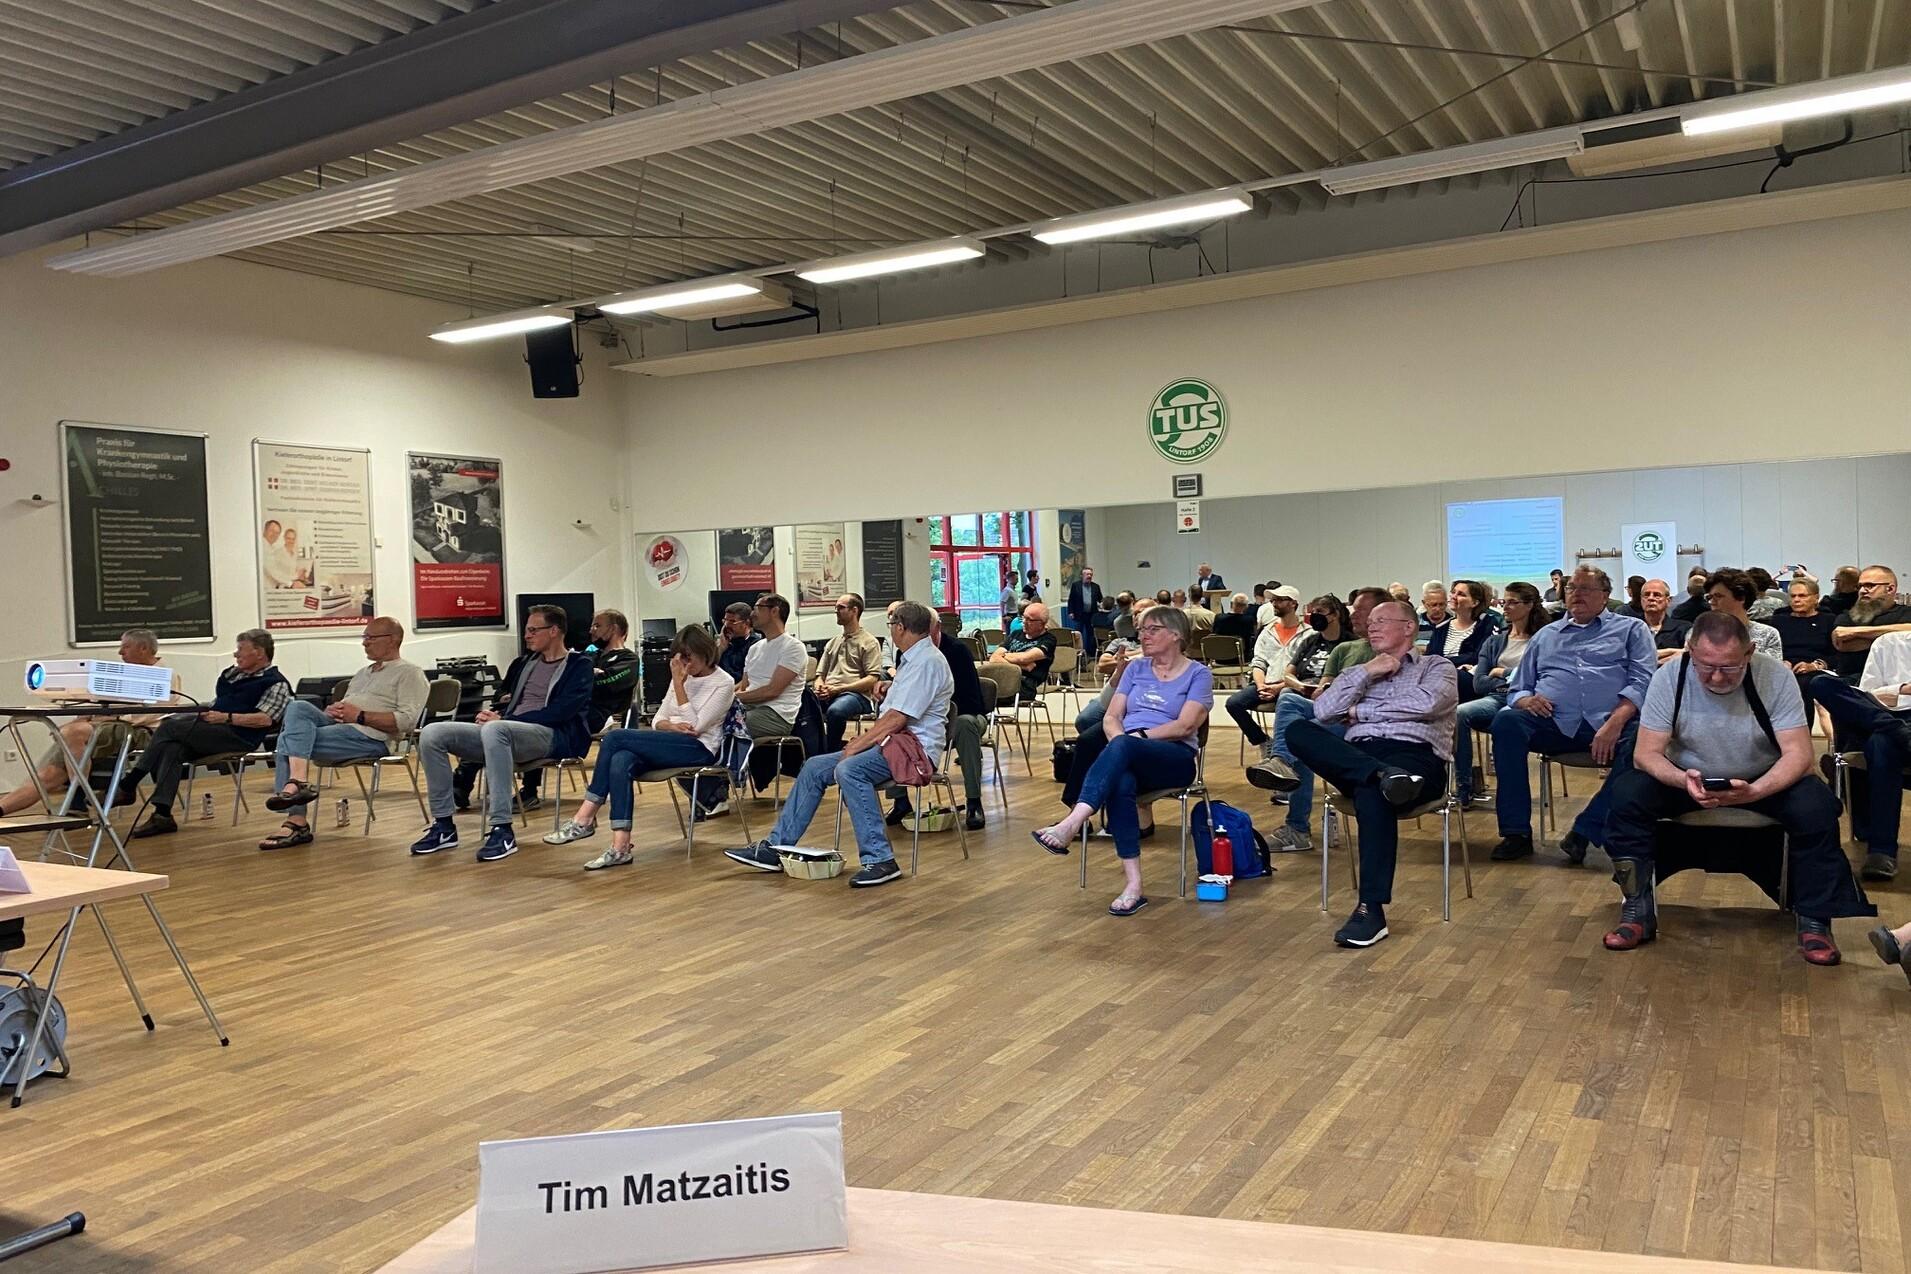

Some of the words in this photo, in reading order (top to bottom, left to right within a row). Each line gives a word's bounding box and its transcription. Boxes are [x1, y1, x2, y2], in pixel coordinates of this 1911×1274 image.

[1156, 403, 1219, 432] TUS
[96, 437, 122, 447] Praxis
[123, 439, 136, 448] für
[96, 448, 171, 460] Krankengymnastik
[172, 453, 188, 462] und
[1168, 446, 1198, 457] LINTORF
[97, 459, 159, 470] Physiotherapie
[537, 1181, 608, 1213] Tim
[623, 1162, 791, 1206] Matzaitis
